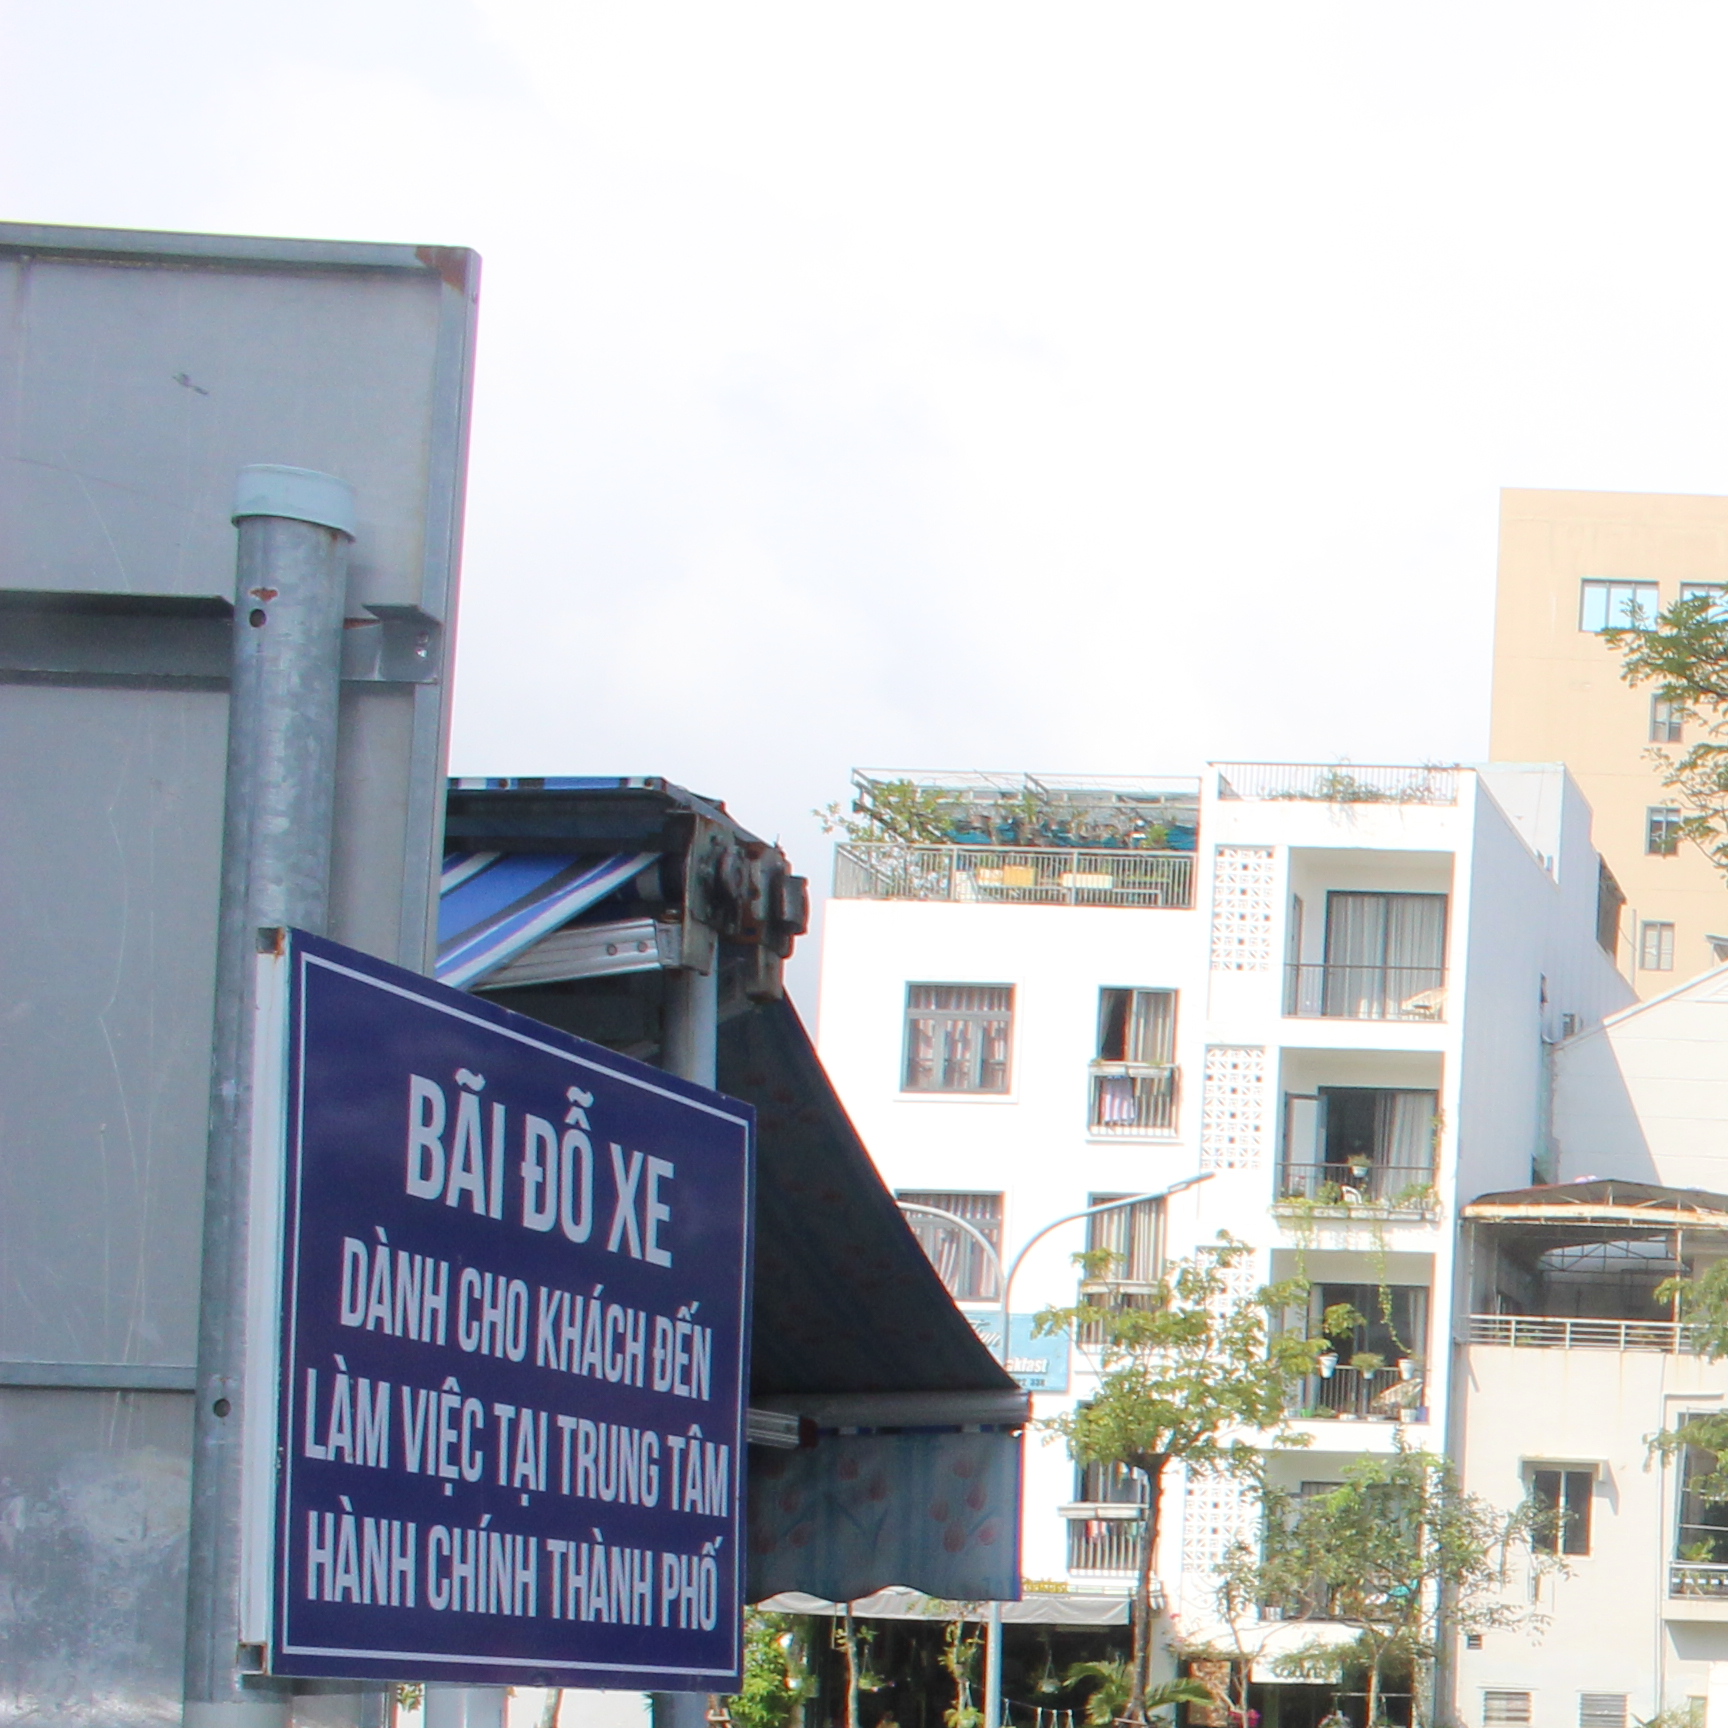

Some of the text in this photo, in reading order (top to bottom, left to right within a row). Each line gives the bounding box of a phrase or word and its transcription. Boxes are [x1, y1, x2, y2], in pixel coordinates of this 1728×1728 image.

[406, 1067, 674, 1268] BÃI ĐỖ XE
[341, 1226, 713, 1402] DÀNH CHO KHÁCH ĐẾN
[305, 1354, 729, 1518] LÀM VIỆC TẠI TRUNG TÂM
[307, 1495, 722, 1632] HÀNH CHÍNH THÀNH PHỐ
